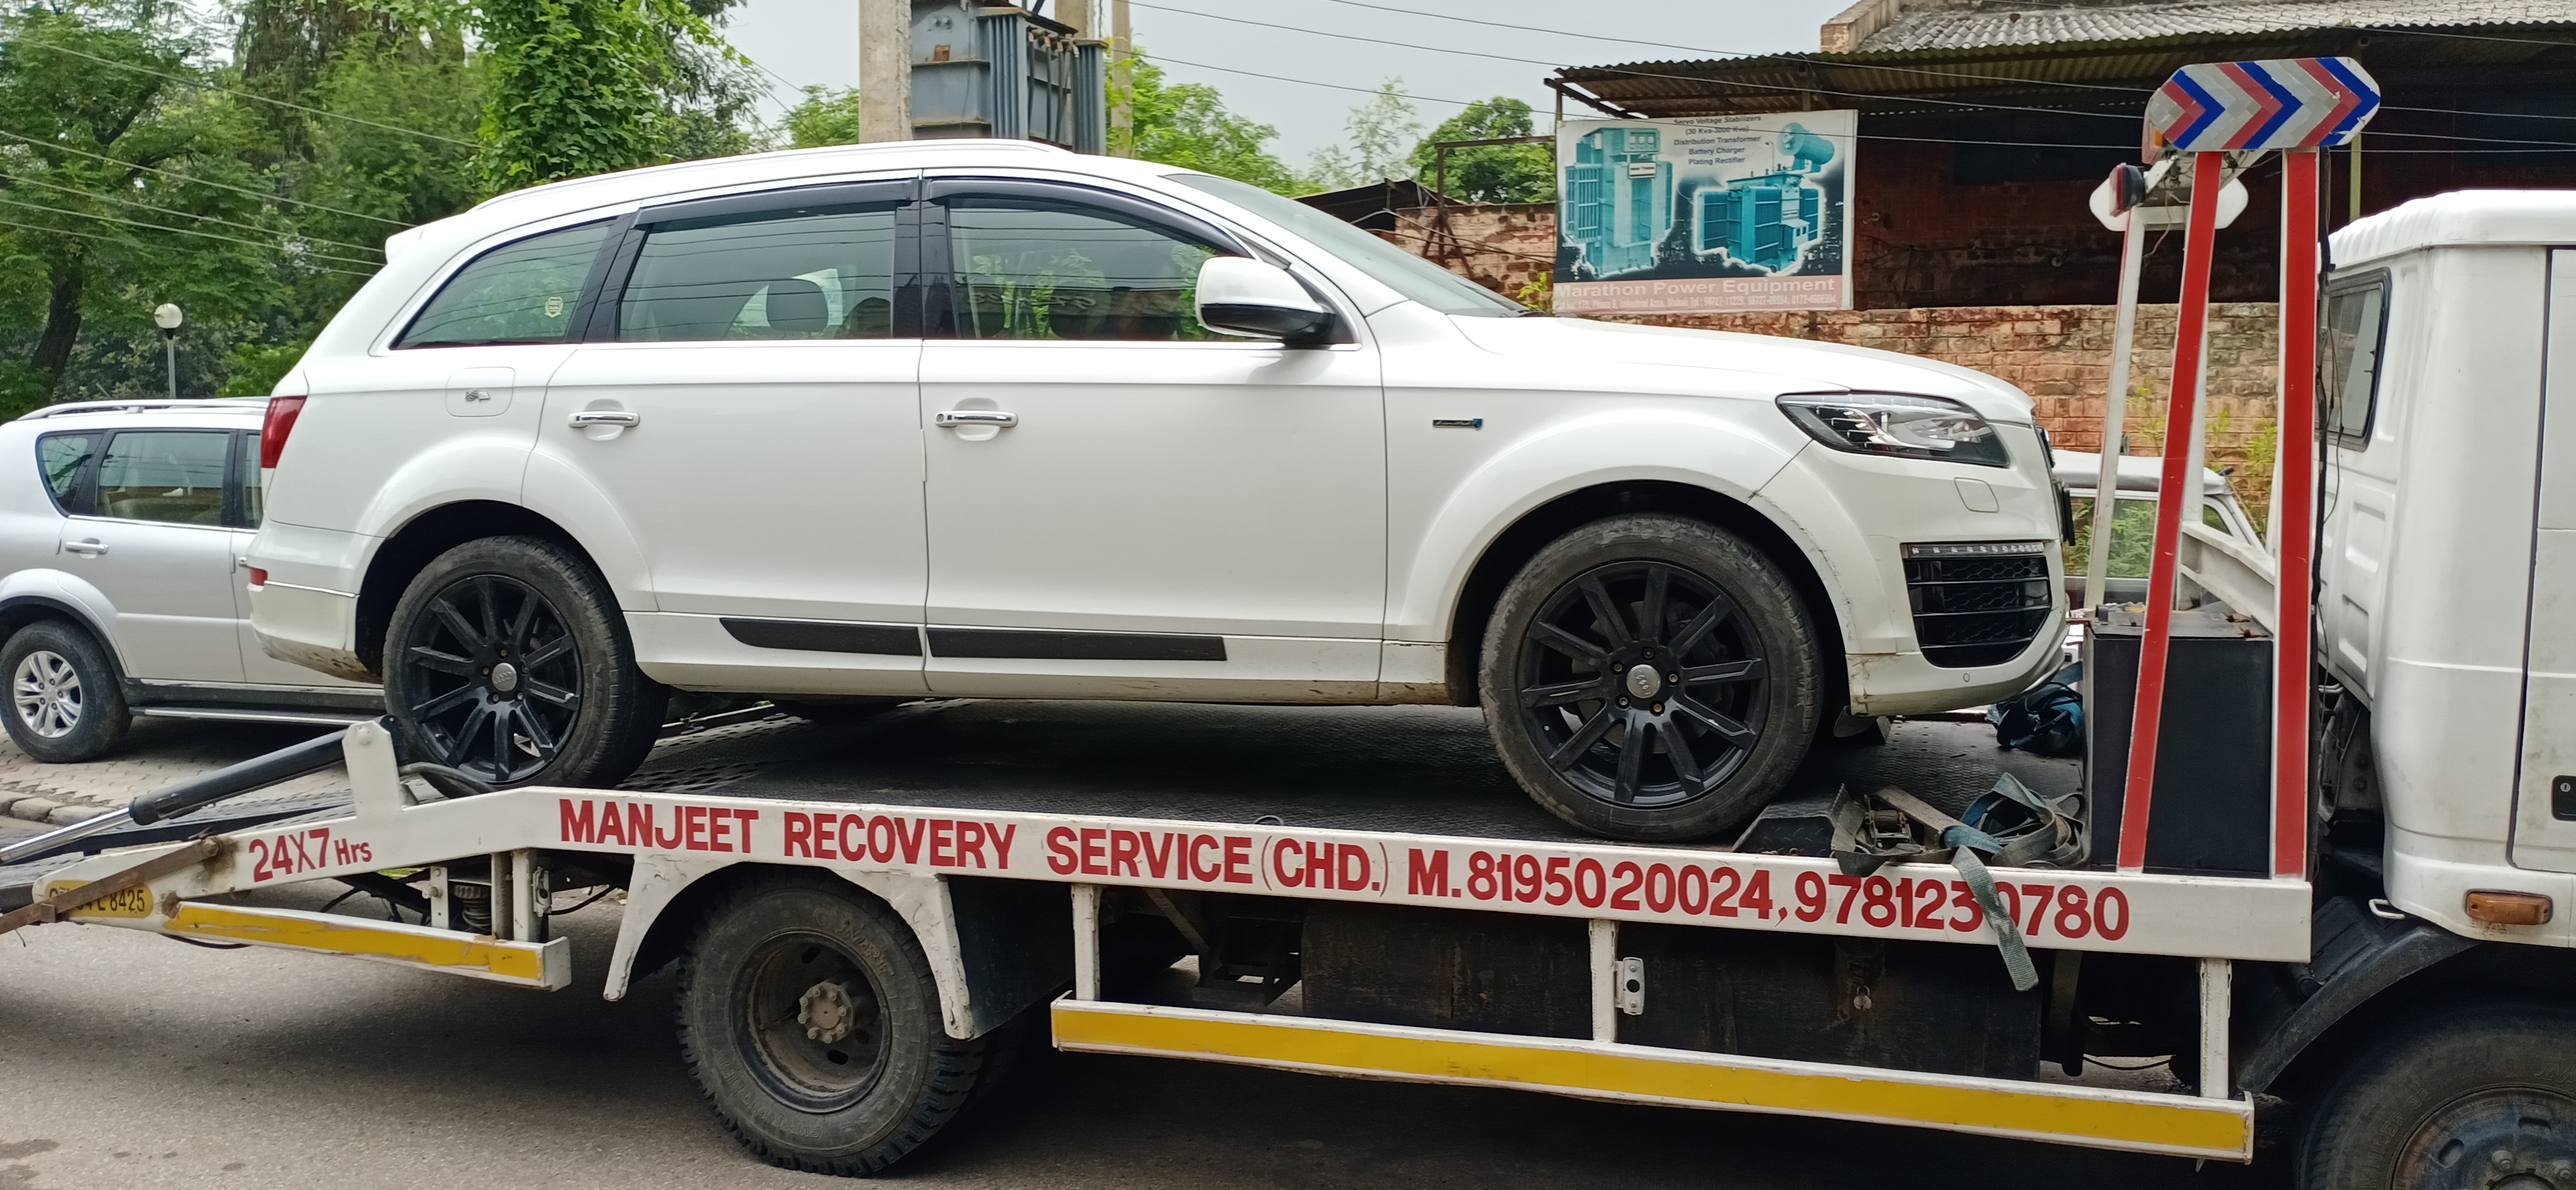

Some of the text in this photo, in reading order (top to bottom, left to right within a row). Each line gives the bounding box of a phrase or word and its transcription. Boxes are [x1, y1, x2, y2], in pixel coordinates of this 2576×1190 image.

[1554, 278, 1835, 297] Marathon Power Equipment
[249, 828, 372, 882] 24X7 Hrs
[560, 799, 759, 853] MANJEET
[784, 811, 1016, 870] RECOVERY
